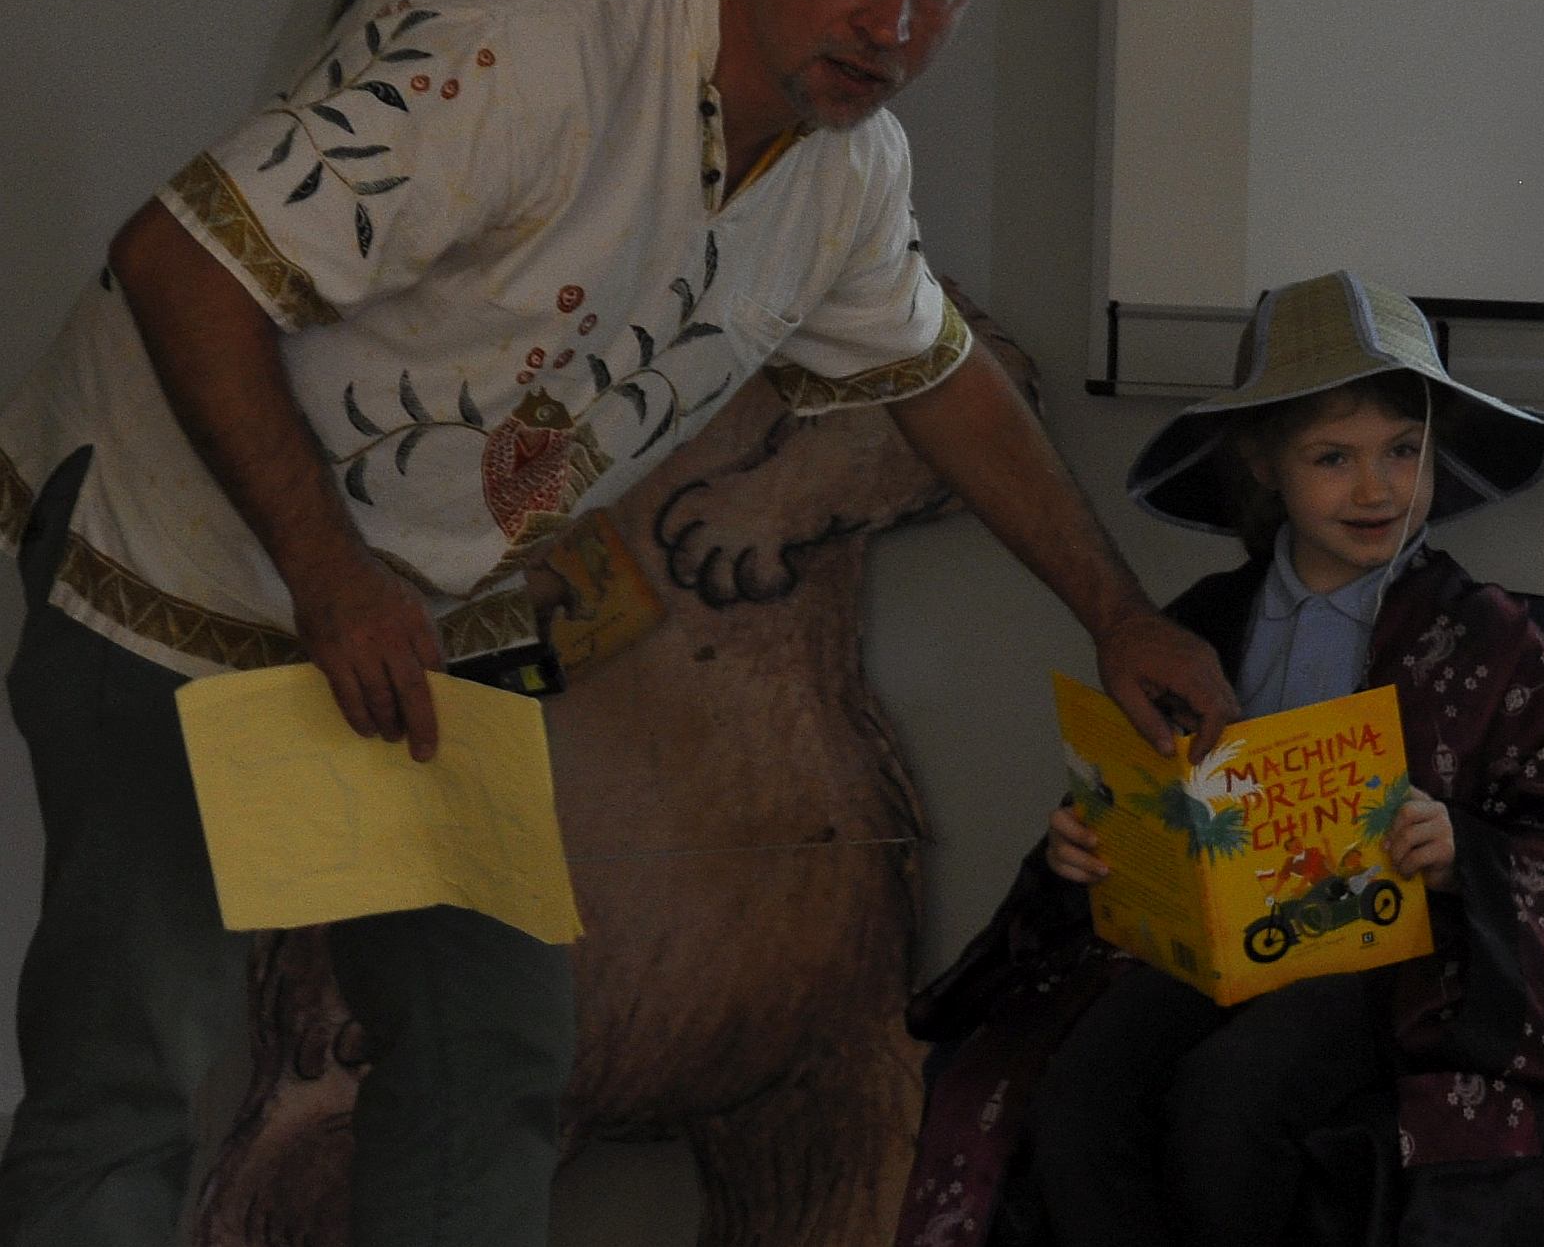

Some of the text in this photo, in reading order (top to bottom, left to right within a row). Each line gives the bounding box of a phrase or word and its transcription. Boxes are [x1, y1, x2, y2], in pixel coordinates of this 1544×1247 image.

[1224, 723, 1386, 792] MACHINĄ
[1241, 761, 1365, 826] PRZEZ
[1252, 791, 1362, 851] CHINY
